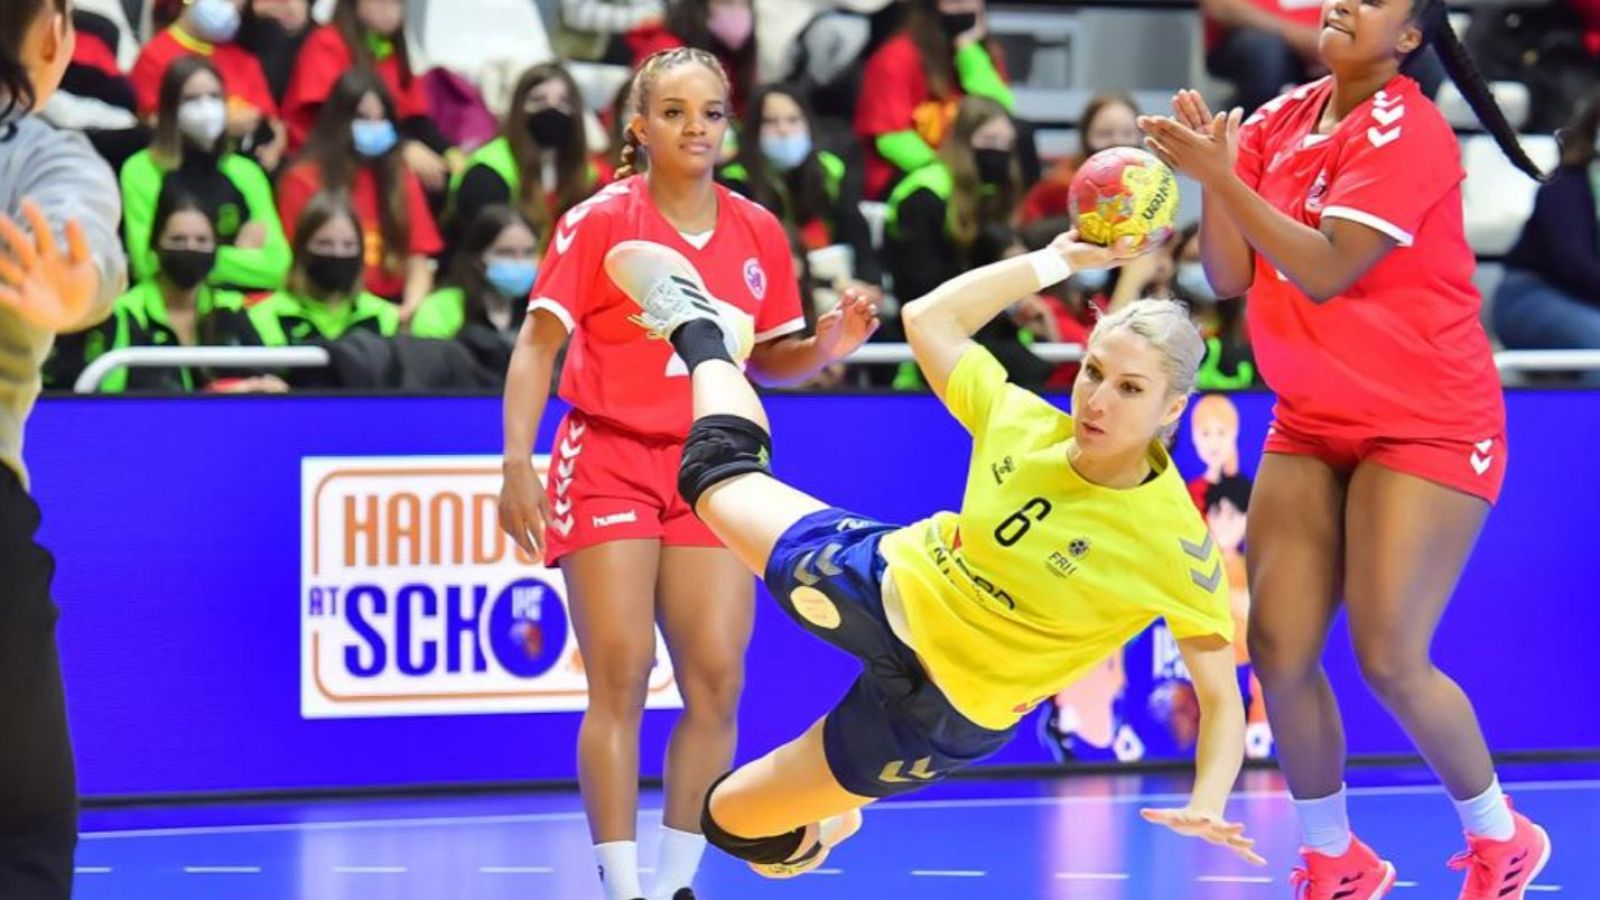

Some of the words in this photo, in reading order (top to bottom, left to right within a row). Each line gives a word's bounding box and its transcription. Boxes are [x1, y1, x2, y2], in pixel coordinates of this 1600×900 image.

[344, 491, 544, 566] HAND
[994, 496, 1052, 547] 6
[308, 587, 340, 616] AT
